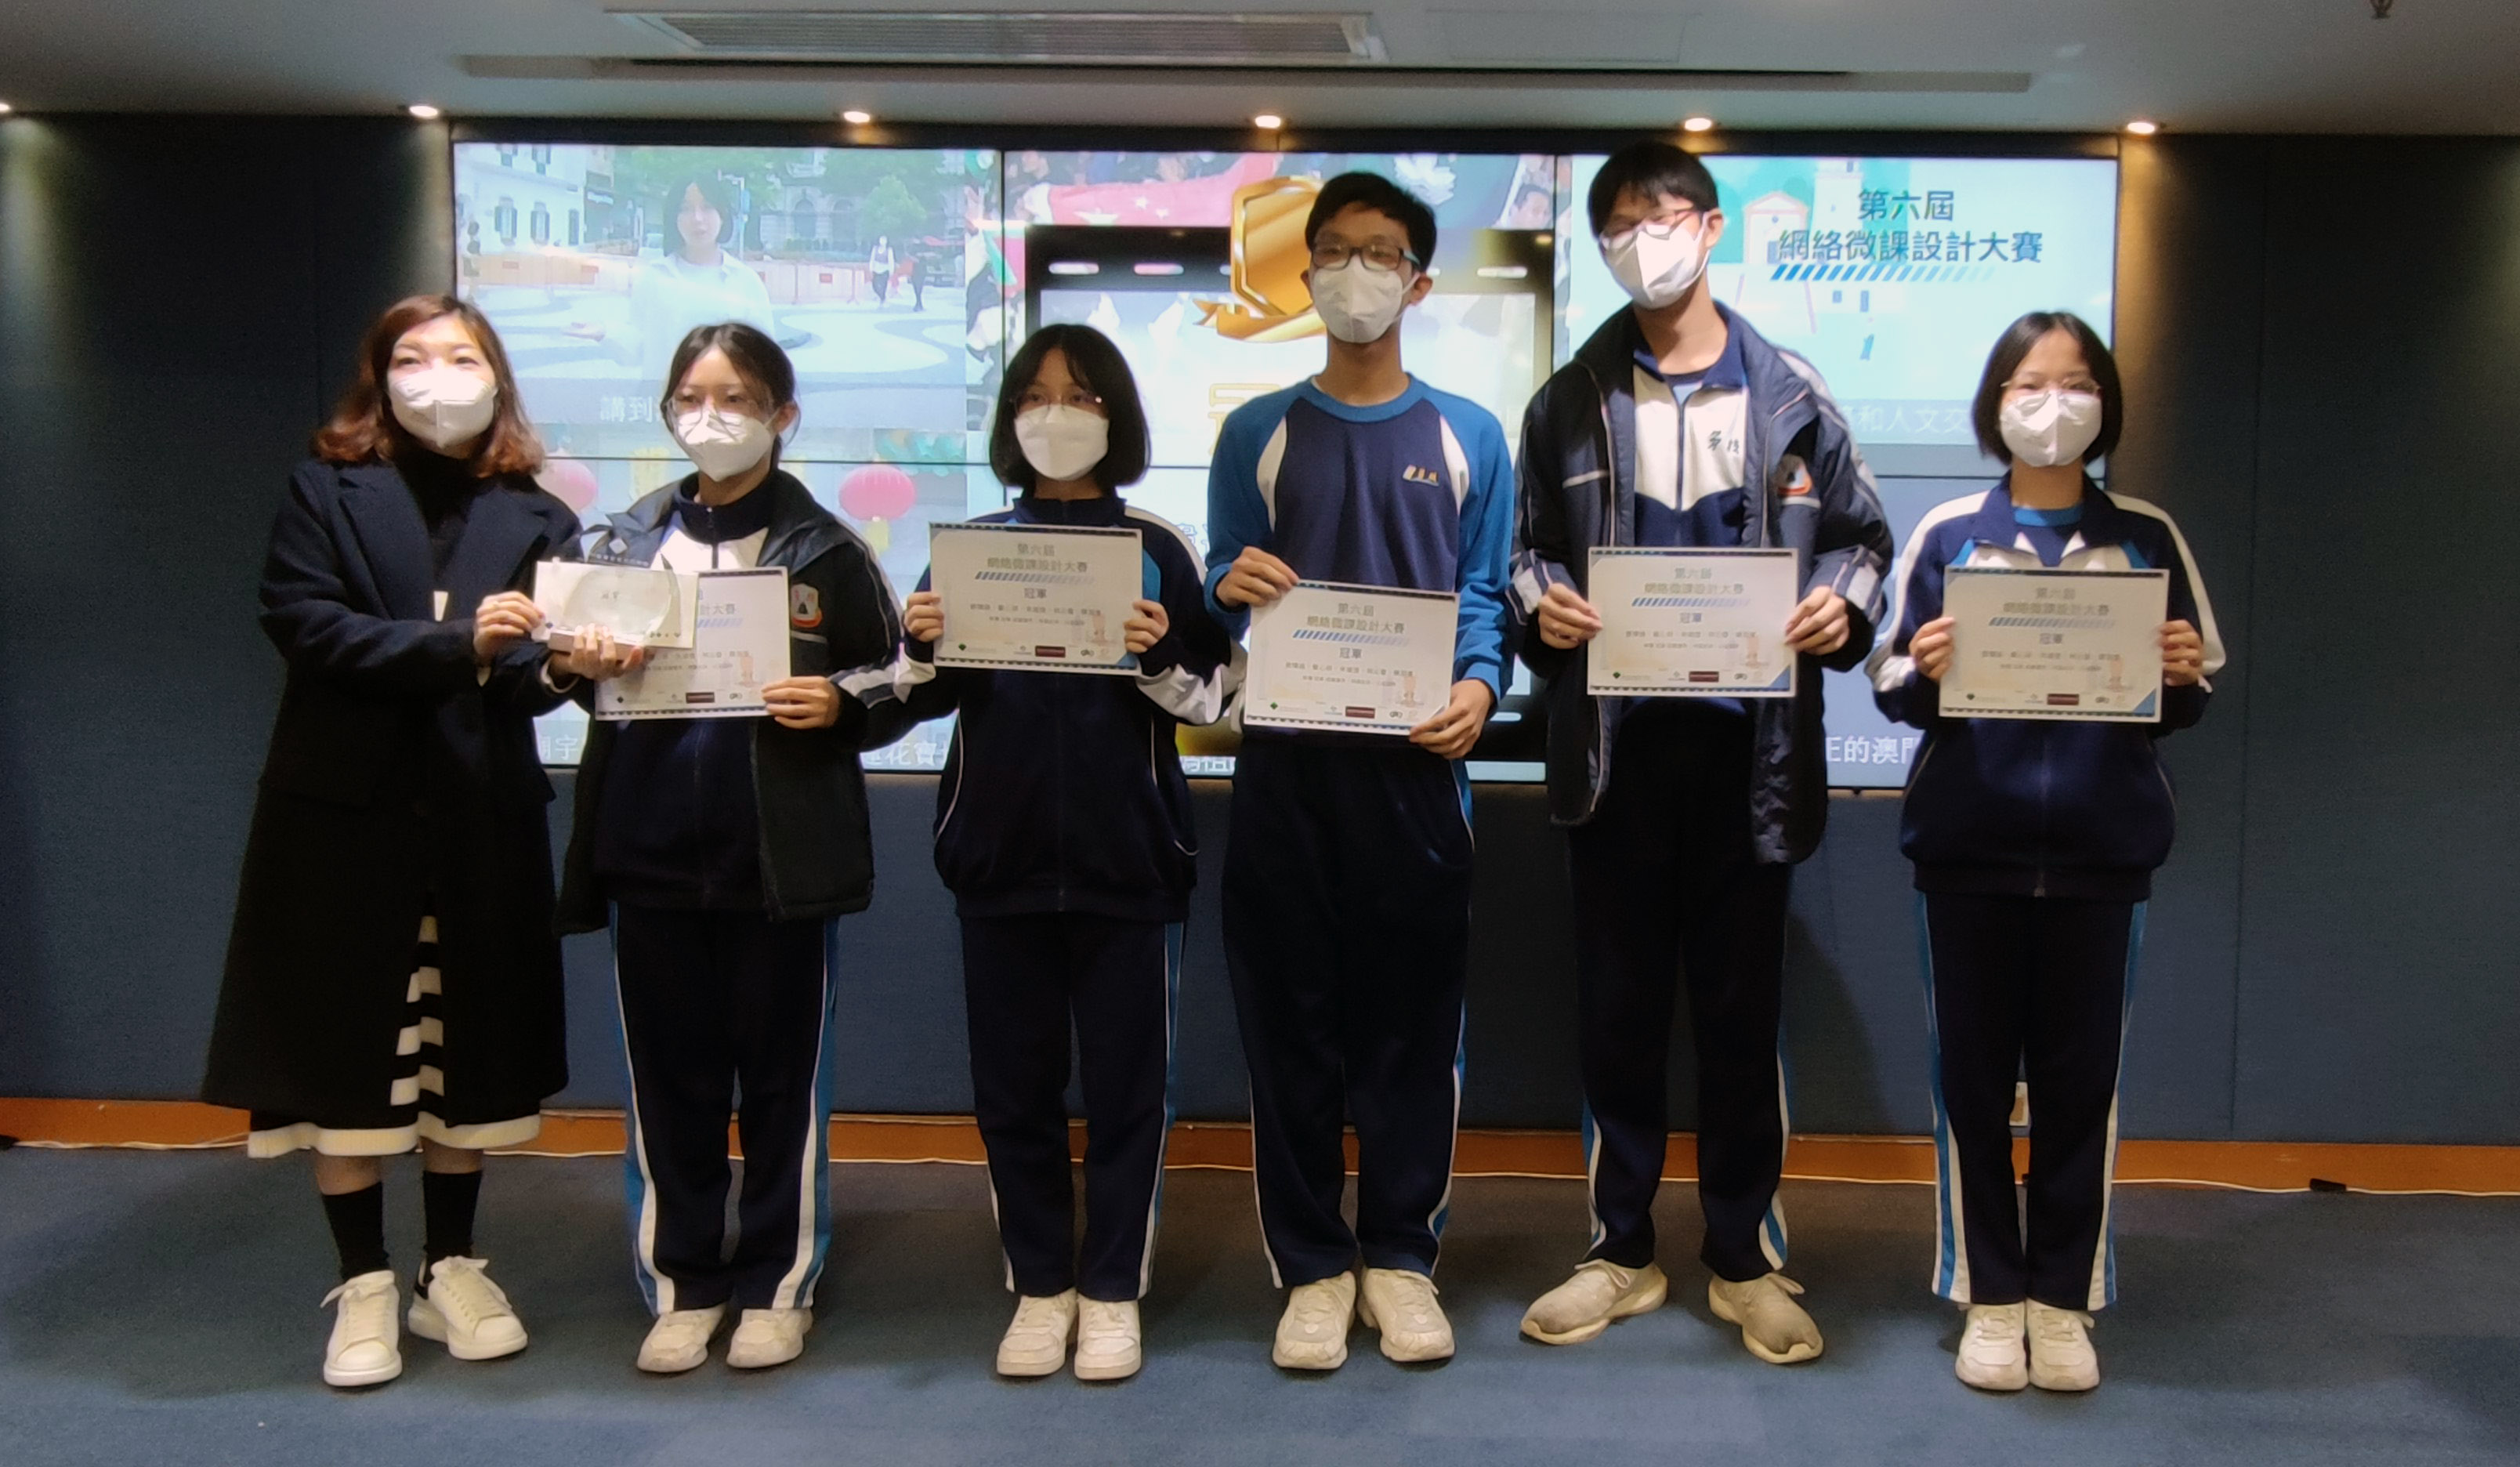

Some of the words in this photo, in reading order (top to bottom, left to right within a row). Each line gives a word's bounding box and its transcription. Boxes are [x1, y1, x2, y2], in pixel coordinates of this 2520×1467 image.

[1858, 189, 1954, 221] 第六屆
[1778, 230, 2043, 263] 網絡微課設計大賽
